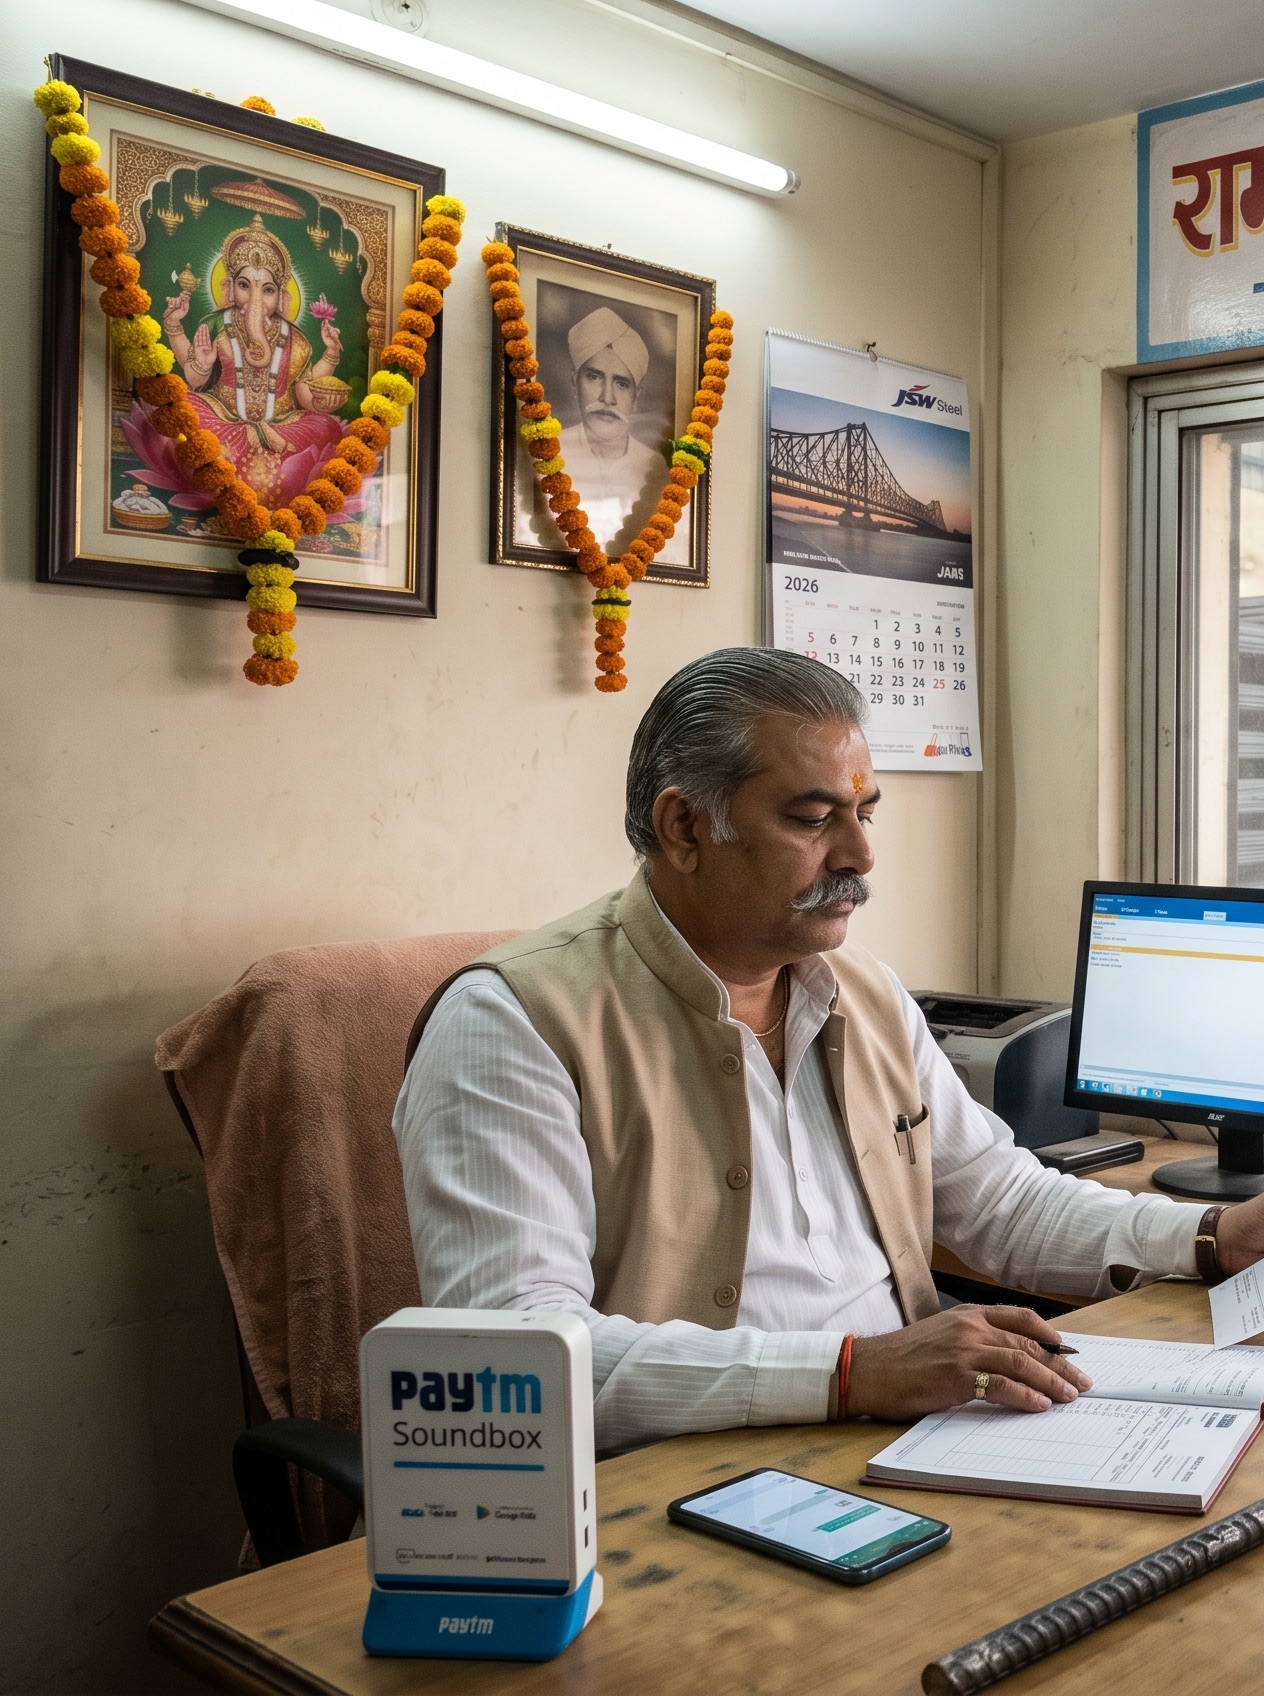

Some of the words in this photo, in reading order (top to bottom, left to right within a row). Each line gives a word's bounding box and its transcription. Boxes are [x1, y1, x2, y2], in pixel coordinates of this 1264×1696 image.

[891, 388, 937, 410] JSW
[937, 400, 963, 416] Steel
[784, 576, 819, 594] 2026
[874, 619, 879, 629] 1
[894, 620, 901, 632] 2
[915, 622, 921, 633] 3
[935, 625, 942, 634] 4
[955, 626, 962, 637] 5
[808, 631, 815, 642] 5
[830, 633, 837, 644] 6
[852, 635, 859, 645] 7
[874, 637, 881, 648] 8
[894, 639, 901, 650] 9
[912, 640, 925, 652] 10
[933, 642, 944, 653] 11
[953, 644, 965, 655] 12
[827, 652, 840, 664] 13
[849, 654, 861, 665] 14
[871, 655, 883, 667] 15
[892, 657, 905, 668] 16
[913, 659, 925, 669] 17
[933, 660, 945, 671] 18
[953, 662, 966, 672] 19
[849, 673, 860, 684] 21
[871, 673, 883, 685] 22
[892, 675, 905, 686] 23
[913, 676, 926, 687] 24
[933, 678, 946, 689] 25
[954, 679, 967, 690] 26
[871, 692, 884, 704] 29
[892, 693, 905, 705] 30
[913, 694, 925, 706] 31
[391, 1367, 542, 1414] paytm
[393, 1421, 543, 1449] Soundbox
[438, 1616, 494, 1635] paytm
